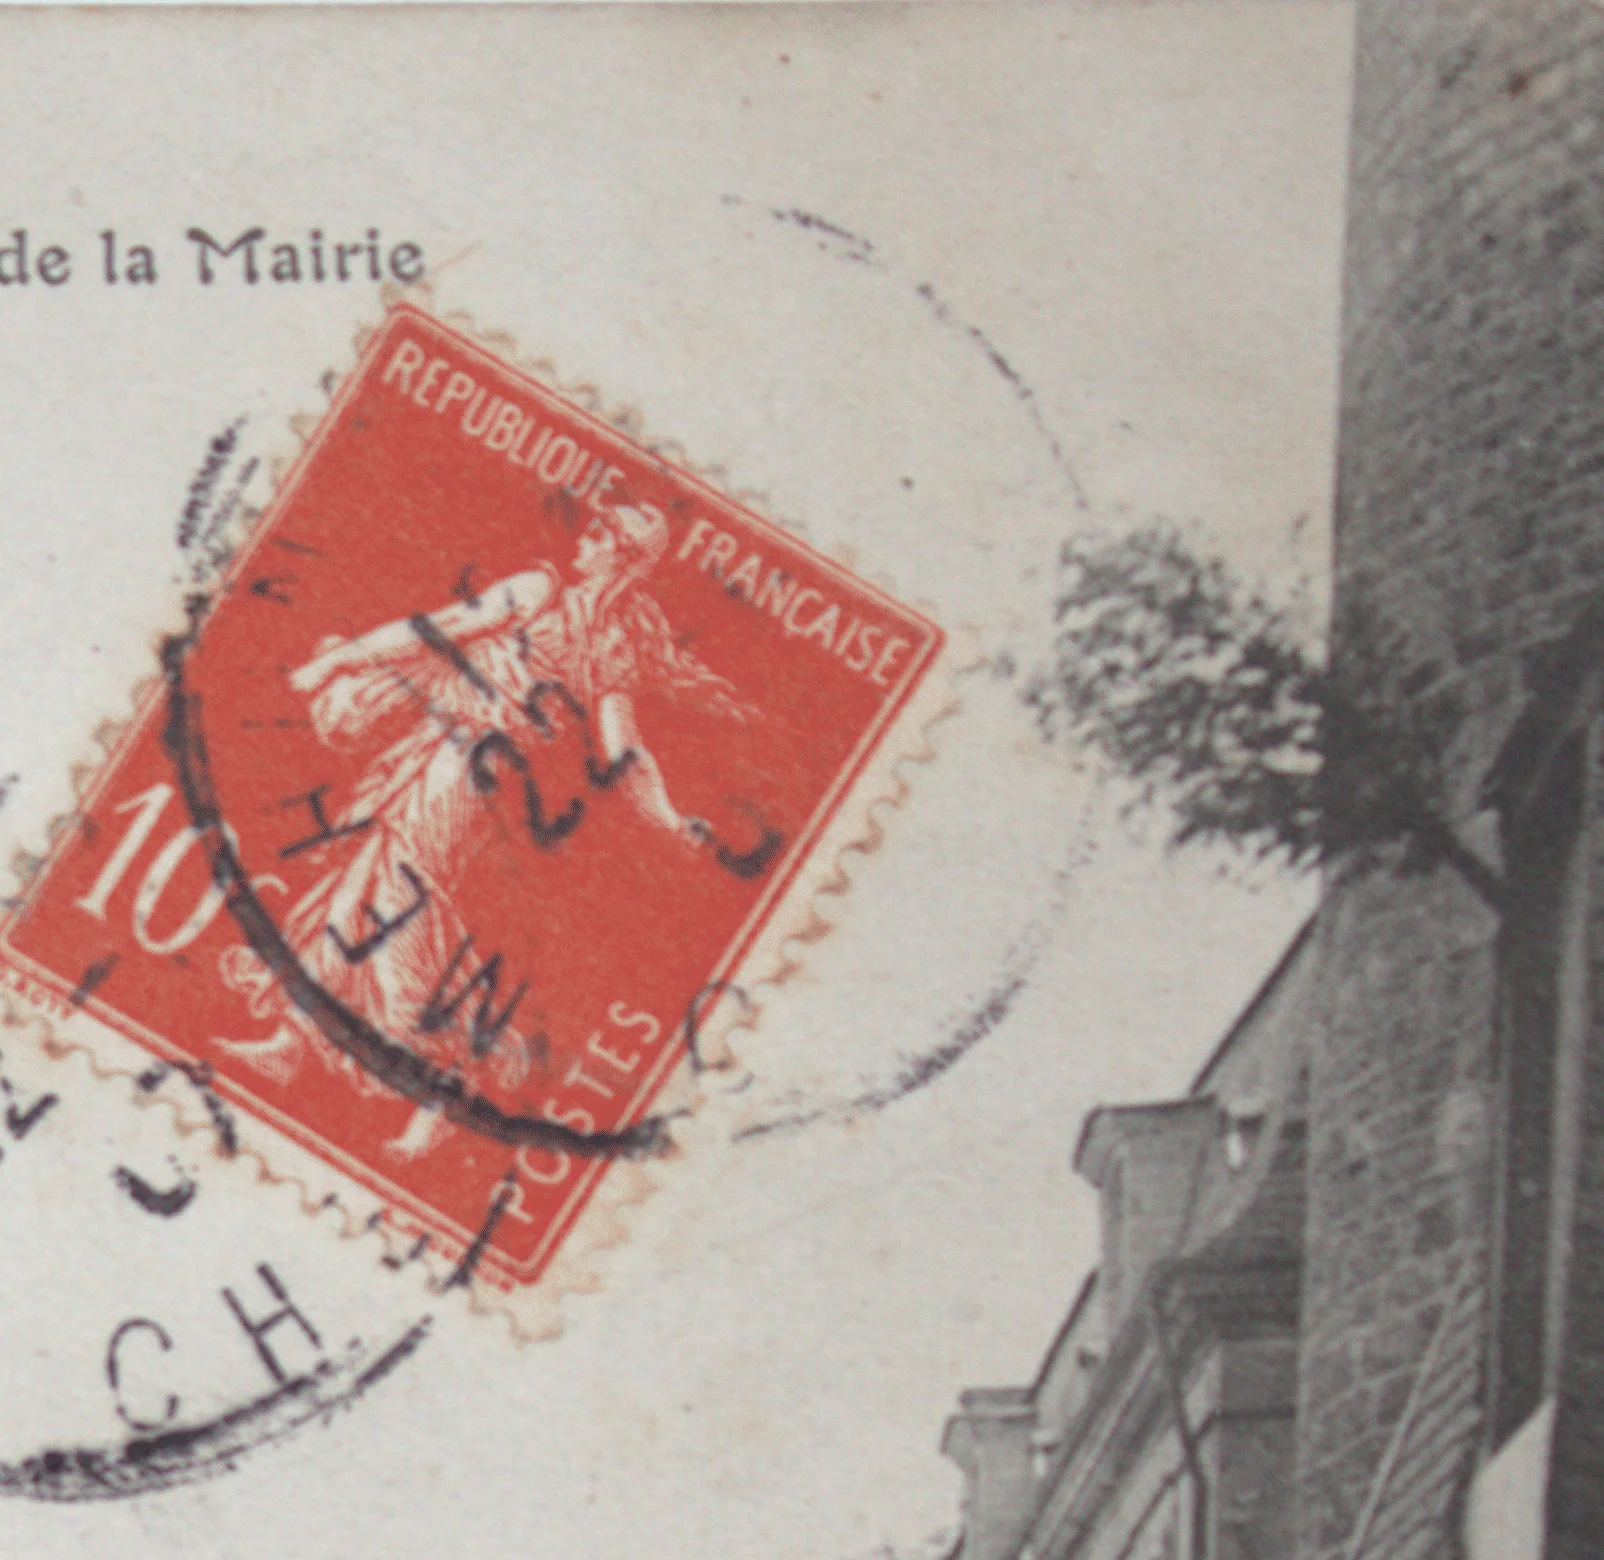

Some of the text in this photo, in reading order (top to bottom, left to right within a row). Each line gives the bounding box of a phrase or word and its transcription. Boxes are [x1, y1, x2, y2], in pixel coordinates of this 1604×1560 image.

[382, 338, 628, 512] REPUBLIQUE
[677, 520, 911, 688] FRANÇAISE
[486, 1000, 662, 1225] POSTES
